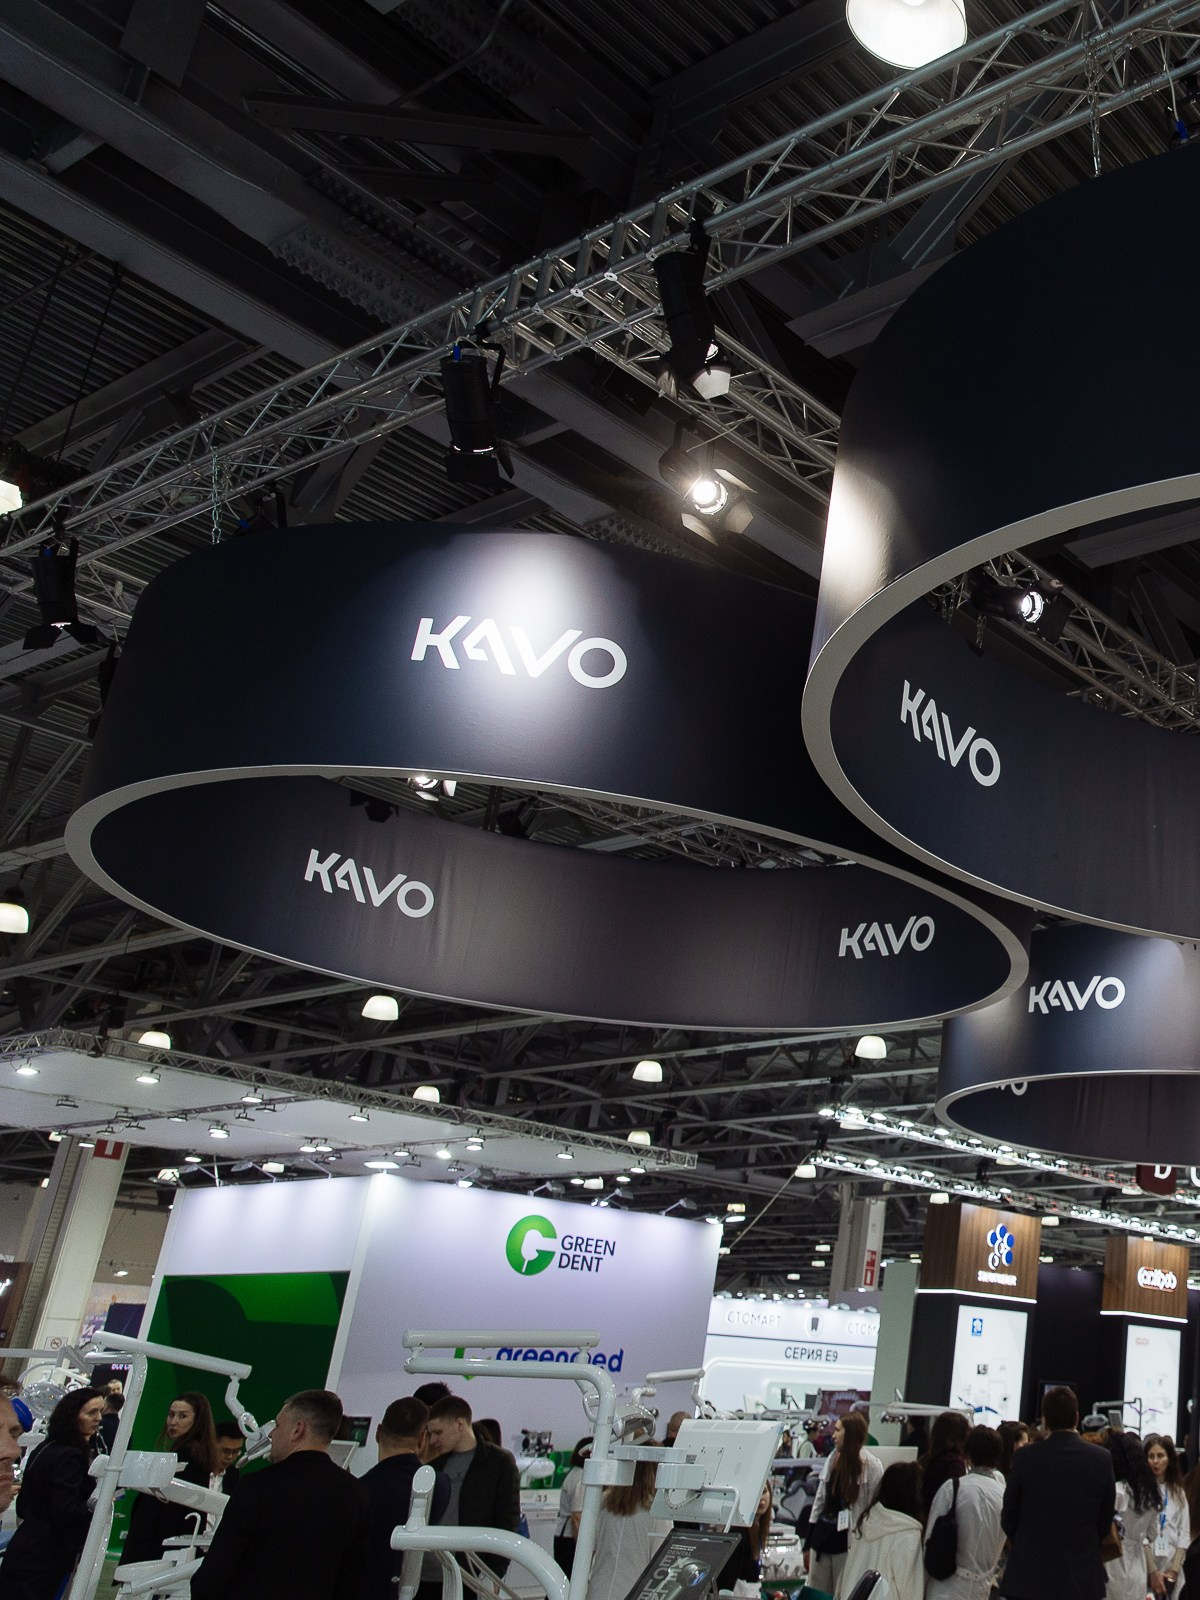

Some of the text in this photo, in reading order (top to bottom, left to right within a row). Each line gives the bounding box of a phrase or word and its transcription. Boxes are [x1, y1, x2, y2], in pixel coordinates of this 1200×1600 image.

[411, 615, 627, 689] KAVO
[901, 679, 1001, 787] KAVO
[304, 848, 435, 918] KAVO
[838, 915, 935, 959] KAVO
[1028, 975, 1126, 1014] KAVO
[558, 1253, 604, 1273] DENT
[561, 1235, 616, 1256] GREEN
[784, 1346, 823, 1361] СЕРИЯ
